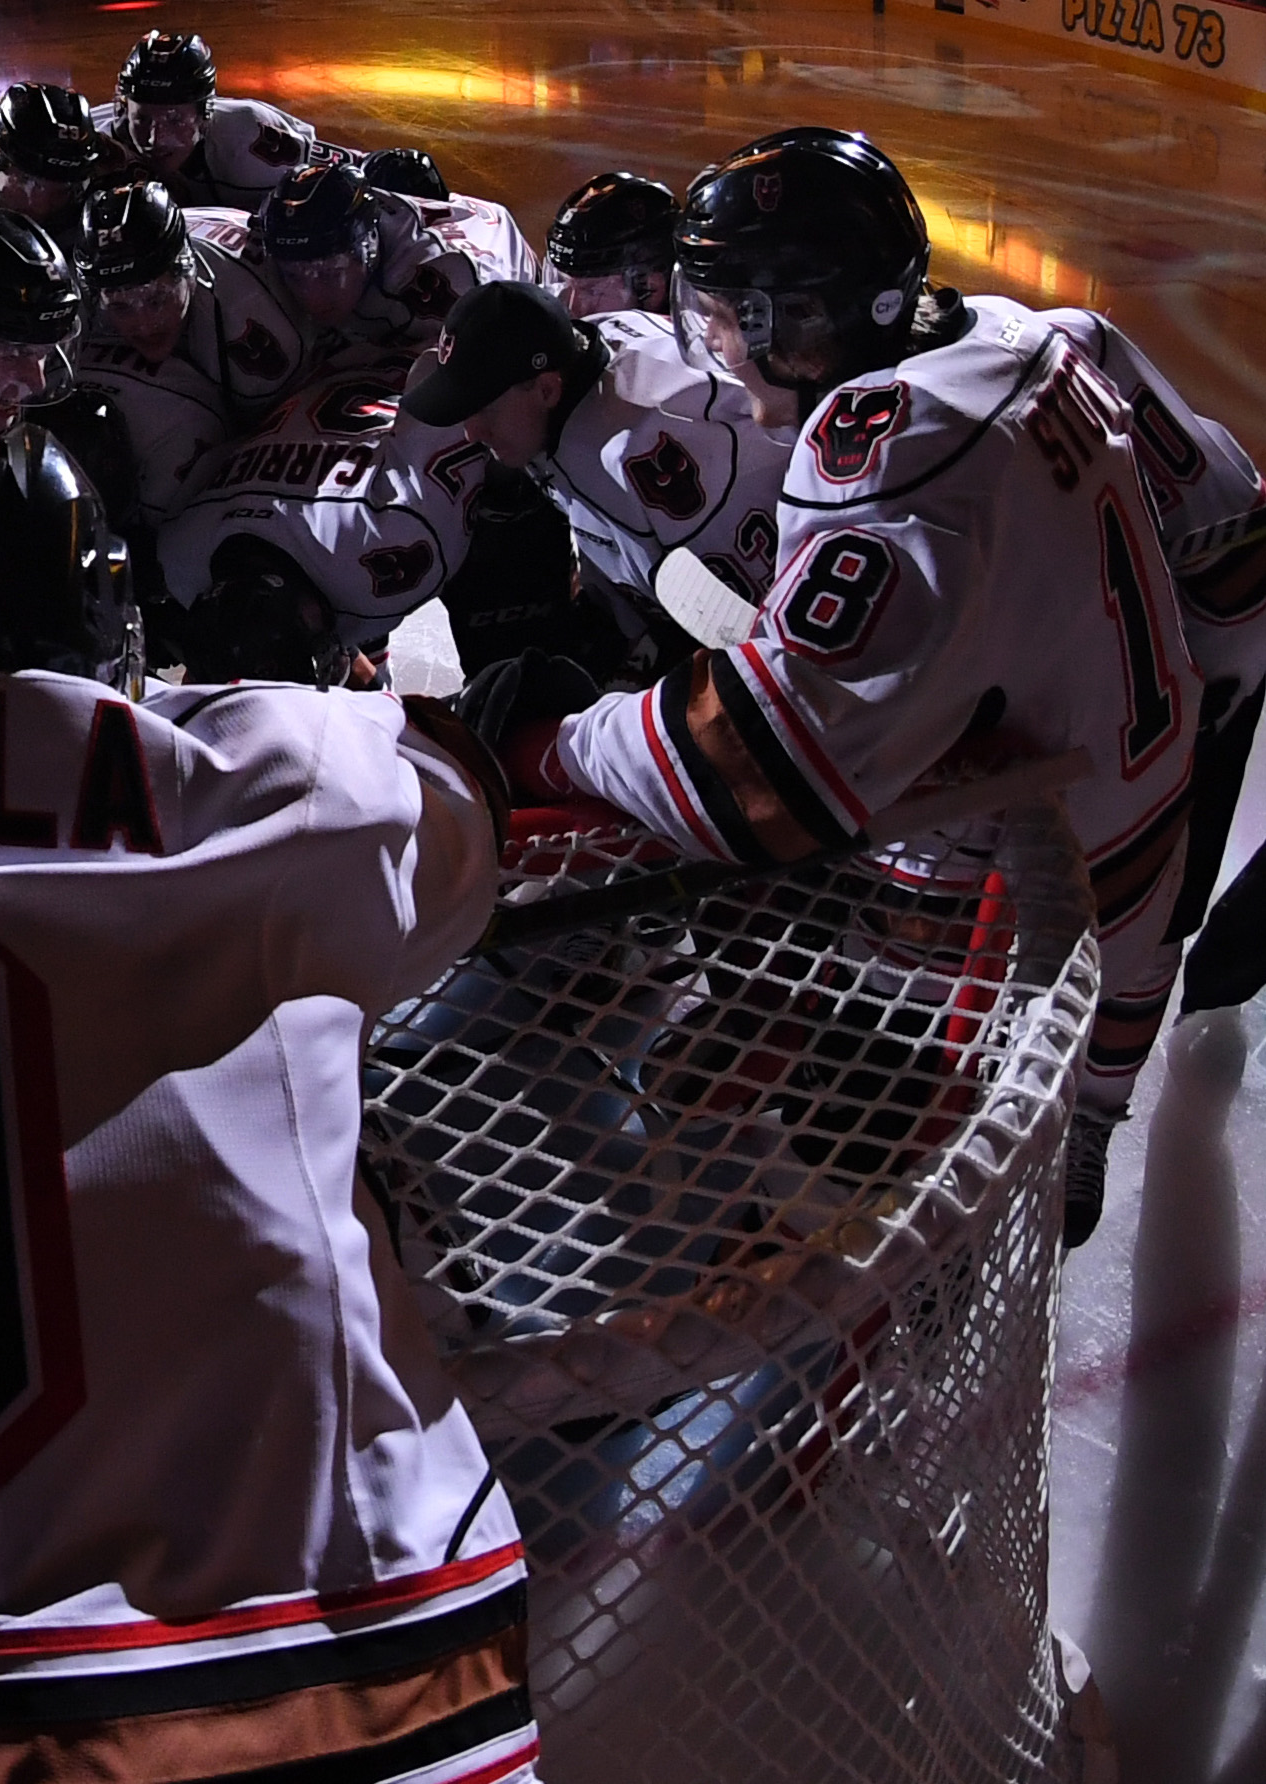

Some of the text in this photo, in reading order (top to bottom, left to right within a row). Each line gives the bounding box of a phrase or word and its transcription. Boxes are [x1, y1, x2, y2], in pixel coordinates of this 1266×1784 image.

[1061, 0, 1225, 68] PIZZA 73
[140, 79, 173, 88] CCM
[57, 123, 80, 140] 23
[47, 157, 82, 167] CCM
[276, 237, 310, 245] CCM
[99, 261, 134, 276] CCM
[38, 305, 74, 321] CCM
[222, 509, 274, 520] CCM
[573, 527, 614, 548] CCM
[469, 602, 553, 628] CCM
